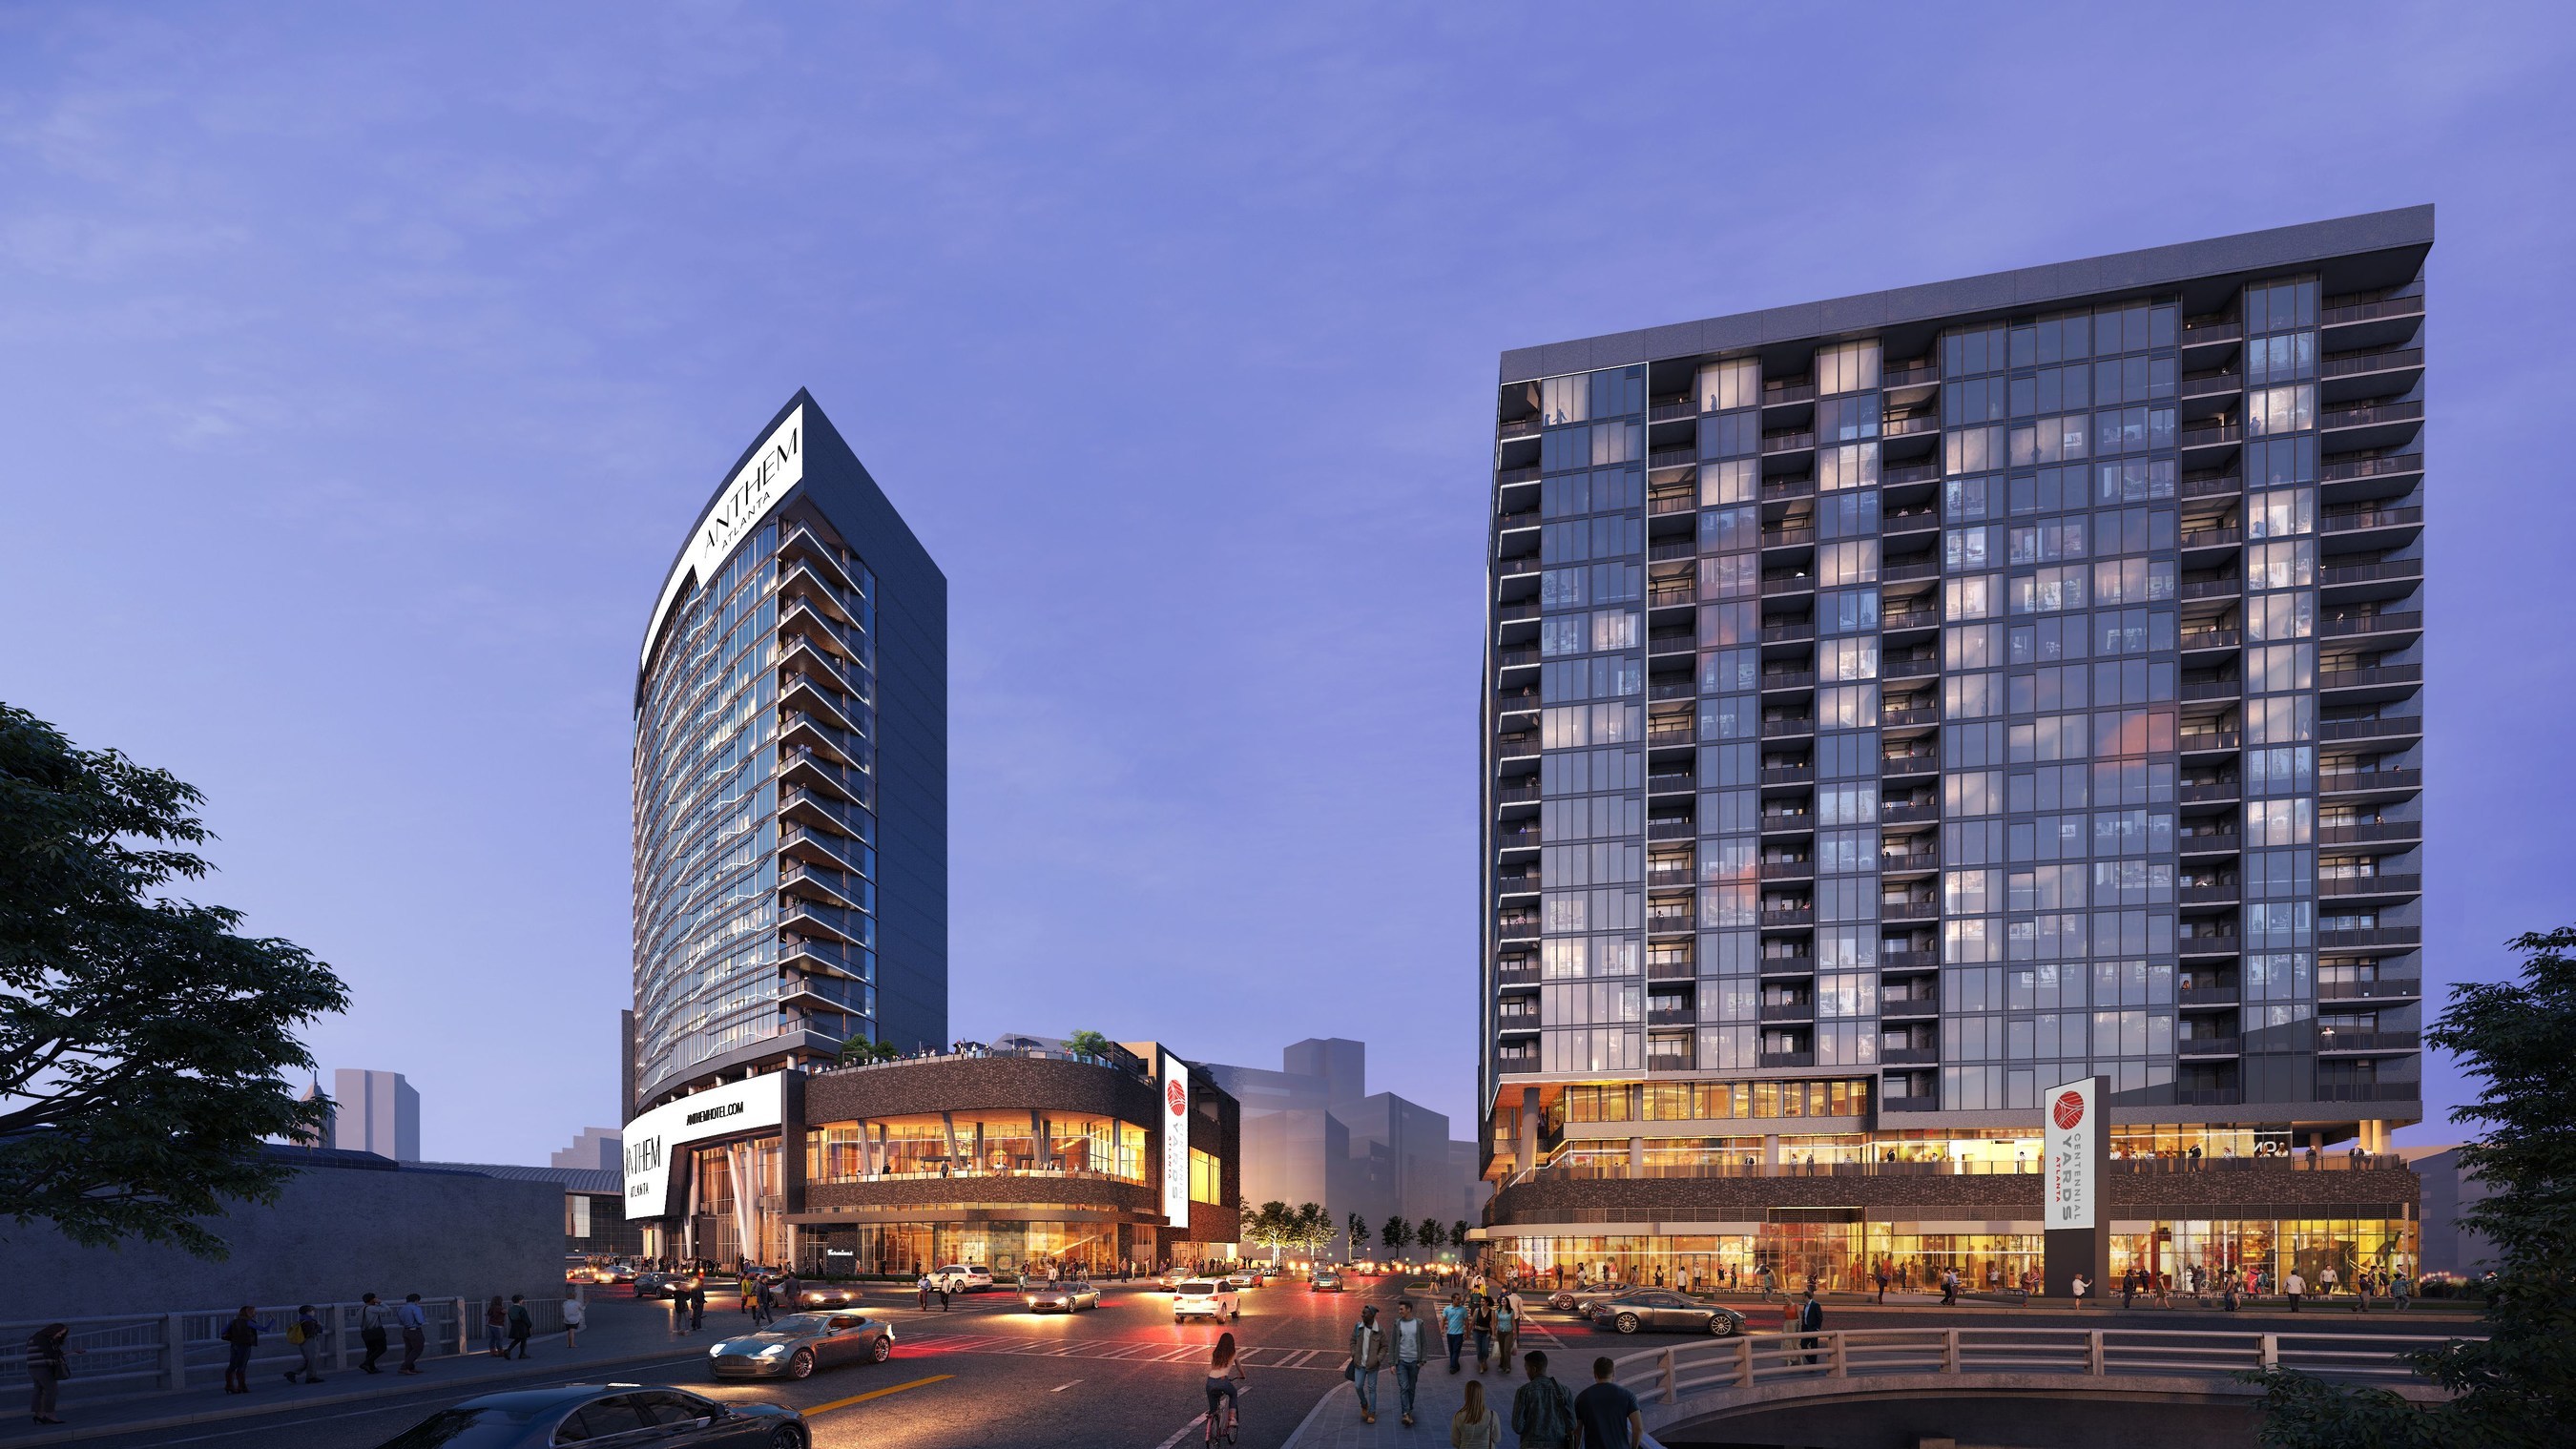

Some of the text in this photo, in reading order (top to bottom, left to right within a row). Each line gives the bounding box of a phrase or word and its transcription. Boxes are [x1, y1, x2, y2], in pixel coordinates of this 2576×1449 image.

[705, 427, 797, 559] ANTHEM
[722, 491, 770, 551] ATLANTA
[686, 1101, 743, 1126] ANTHEMHOTEL.COM
[2063, 1134, 2072, 1221] YARDS
